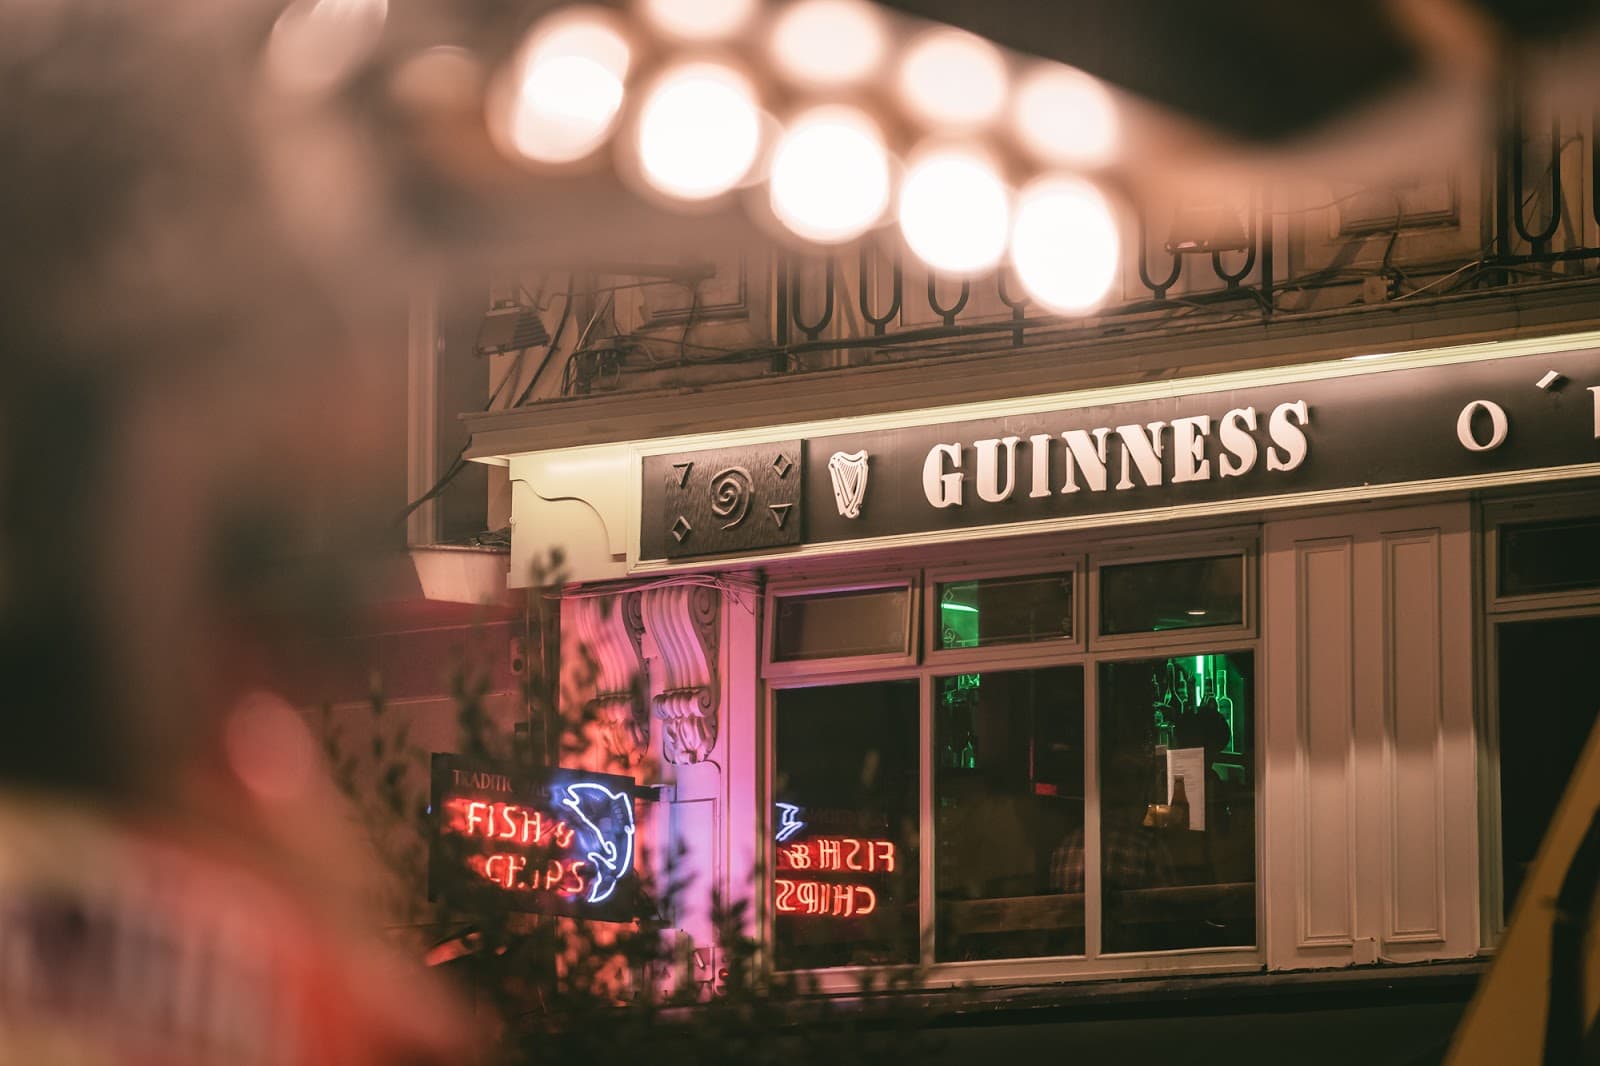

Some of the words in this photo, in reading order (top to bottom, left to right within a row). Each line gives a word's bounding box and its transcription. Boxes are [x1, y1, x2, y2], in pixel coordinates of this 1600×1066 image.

[922, 400, 1309, 508] GUINNESS
[467, 802, 541, 843] FISH
[486, 855, 585, 892] CHIPS
